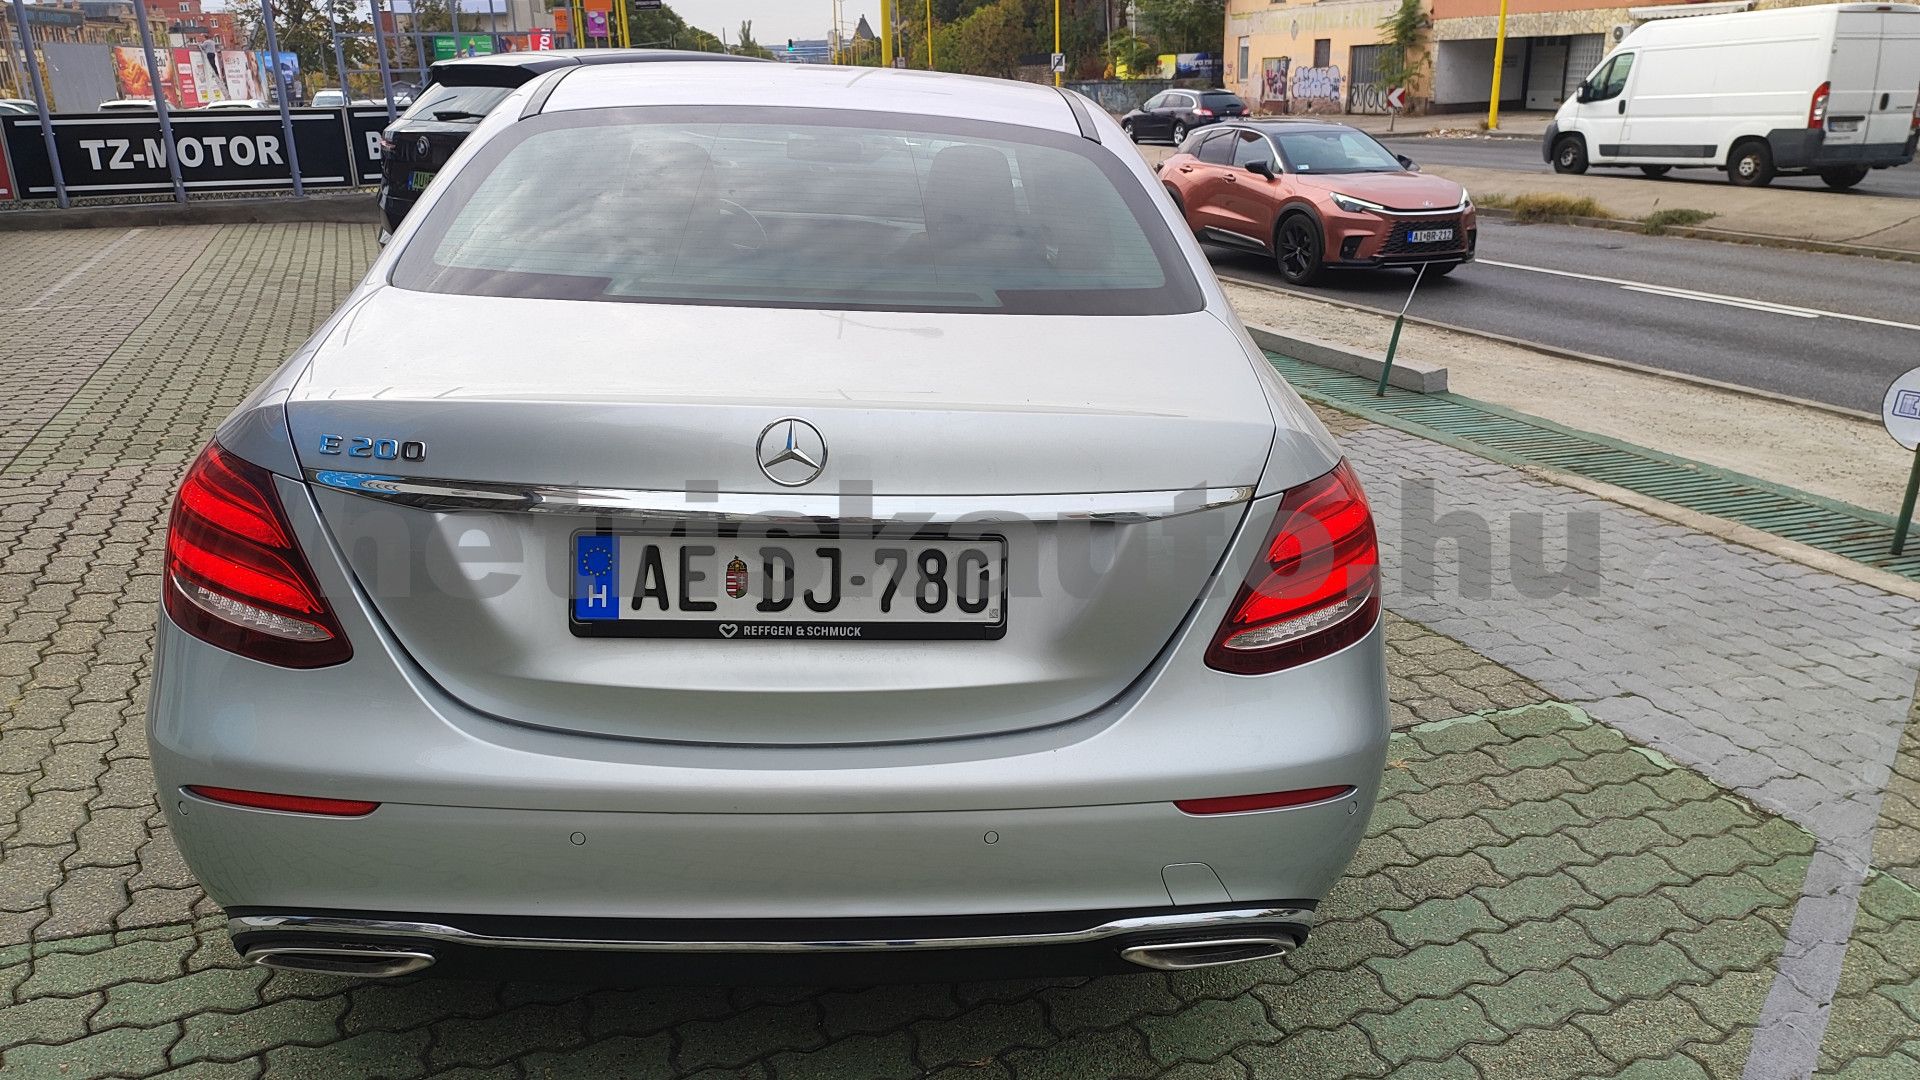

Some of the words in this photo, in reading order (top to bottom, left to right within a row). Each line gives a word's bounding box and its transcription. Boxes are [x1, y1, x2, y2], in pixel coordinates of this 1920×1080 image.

[79, 135, 284, 170] TZ-MOTOR
[320, 433, 342, 455] E
[348, 436, 427, 462] 200
[630, 544, 718, 612] AE
[756, 546, 990, 614] DJ-780
[588, 584, 607, 608] H
[743, 625, 794, 637] REFFGEN
[796, 625, 805, 637] &
[806, 625, 862, 637] SCHMUCK
